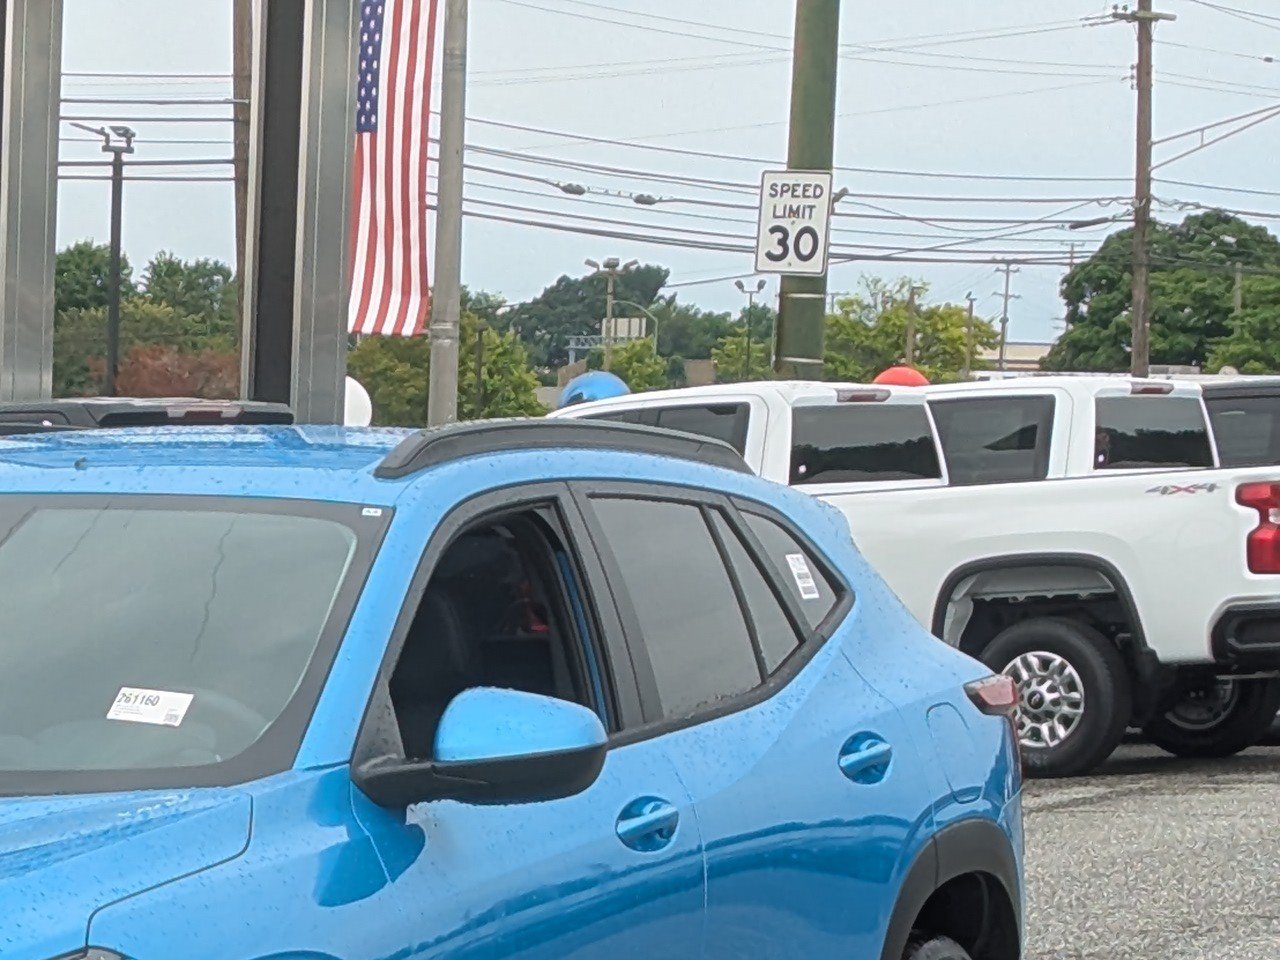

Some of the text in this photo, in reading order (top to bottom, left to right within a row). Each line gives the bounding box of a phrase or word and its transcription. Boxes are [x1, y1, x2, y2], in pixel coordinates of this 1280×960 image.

[768, 182, 824, 199] SPEED
[772, 203, 817, 220] LIMIT
[764, 225, 819, 262] 30
